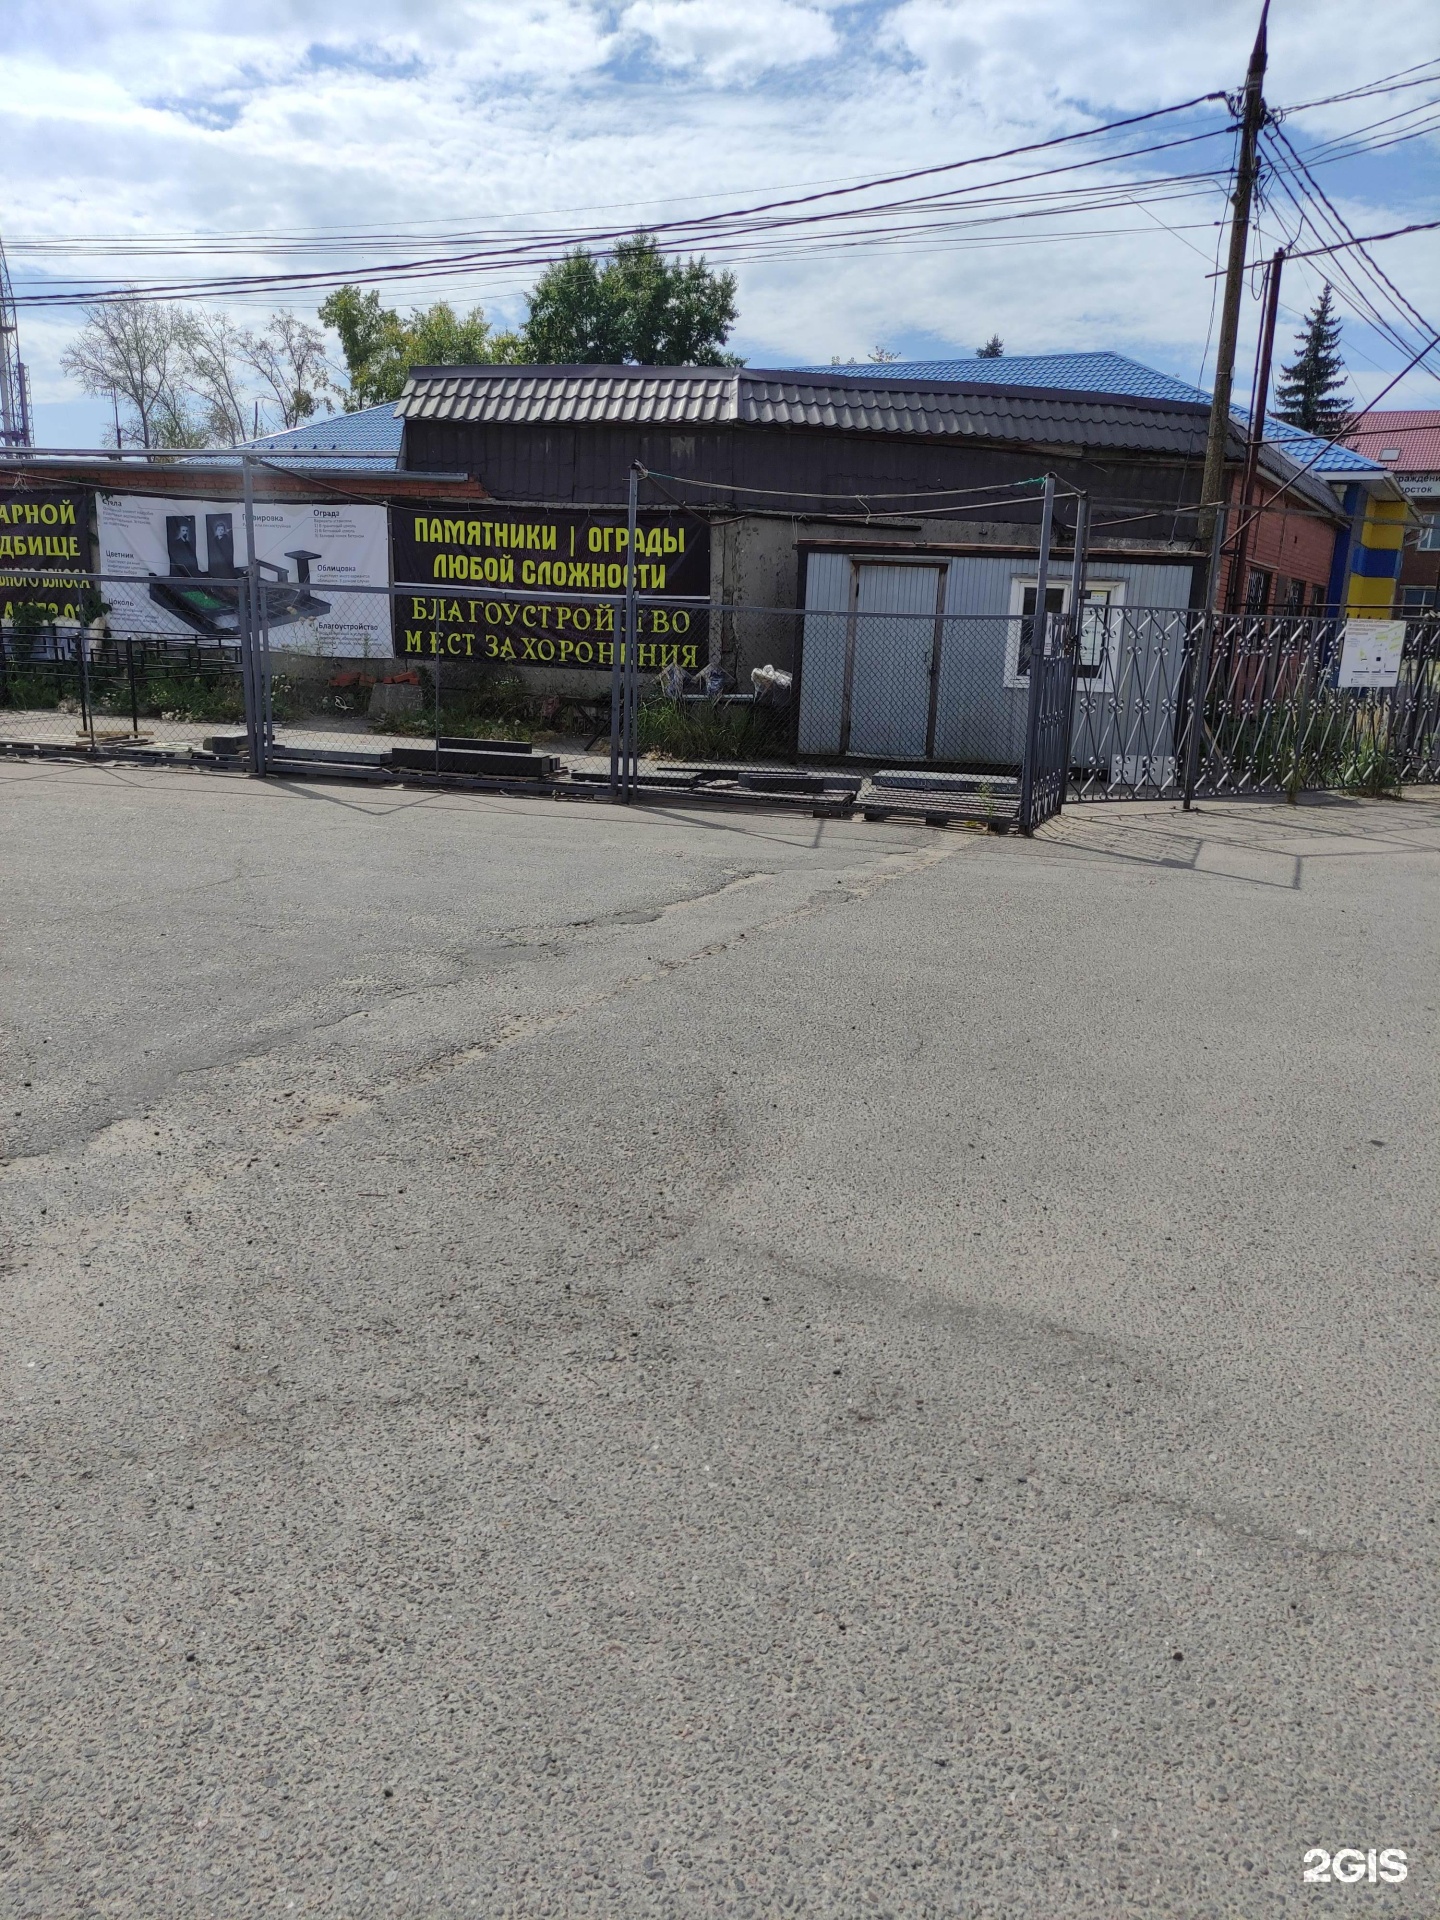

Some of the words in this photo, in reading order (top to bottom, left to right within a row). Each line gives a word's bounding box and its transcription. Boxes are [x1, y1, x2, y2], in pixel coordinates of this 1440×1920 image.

[0, 499, 76, 525] АРНОЙ
[313, 509, 340, 518] Ограда
[414, 517, 557, 551] ПАМЯТНИКИ
[588, 526, 685, 557] ОГРАДЫ
[0, 535, 81, 560] ДБИЩЕ
[106, 550, 135, 559] Цветник
[317, 564, 356, 573] Облицовка
[433, 553, 515, 583] ЛЮБОЙ
[522, 559, 666, 589] СЛОЖНОСТИ
[109, 598, 134, 607] Цоколь
[318, 622, 378, 631] Благоустройство
